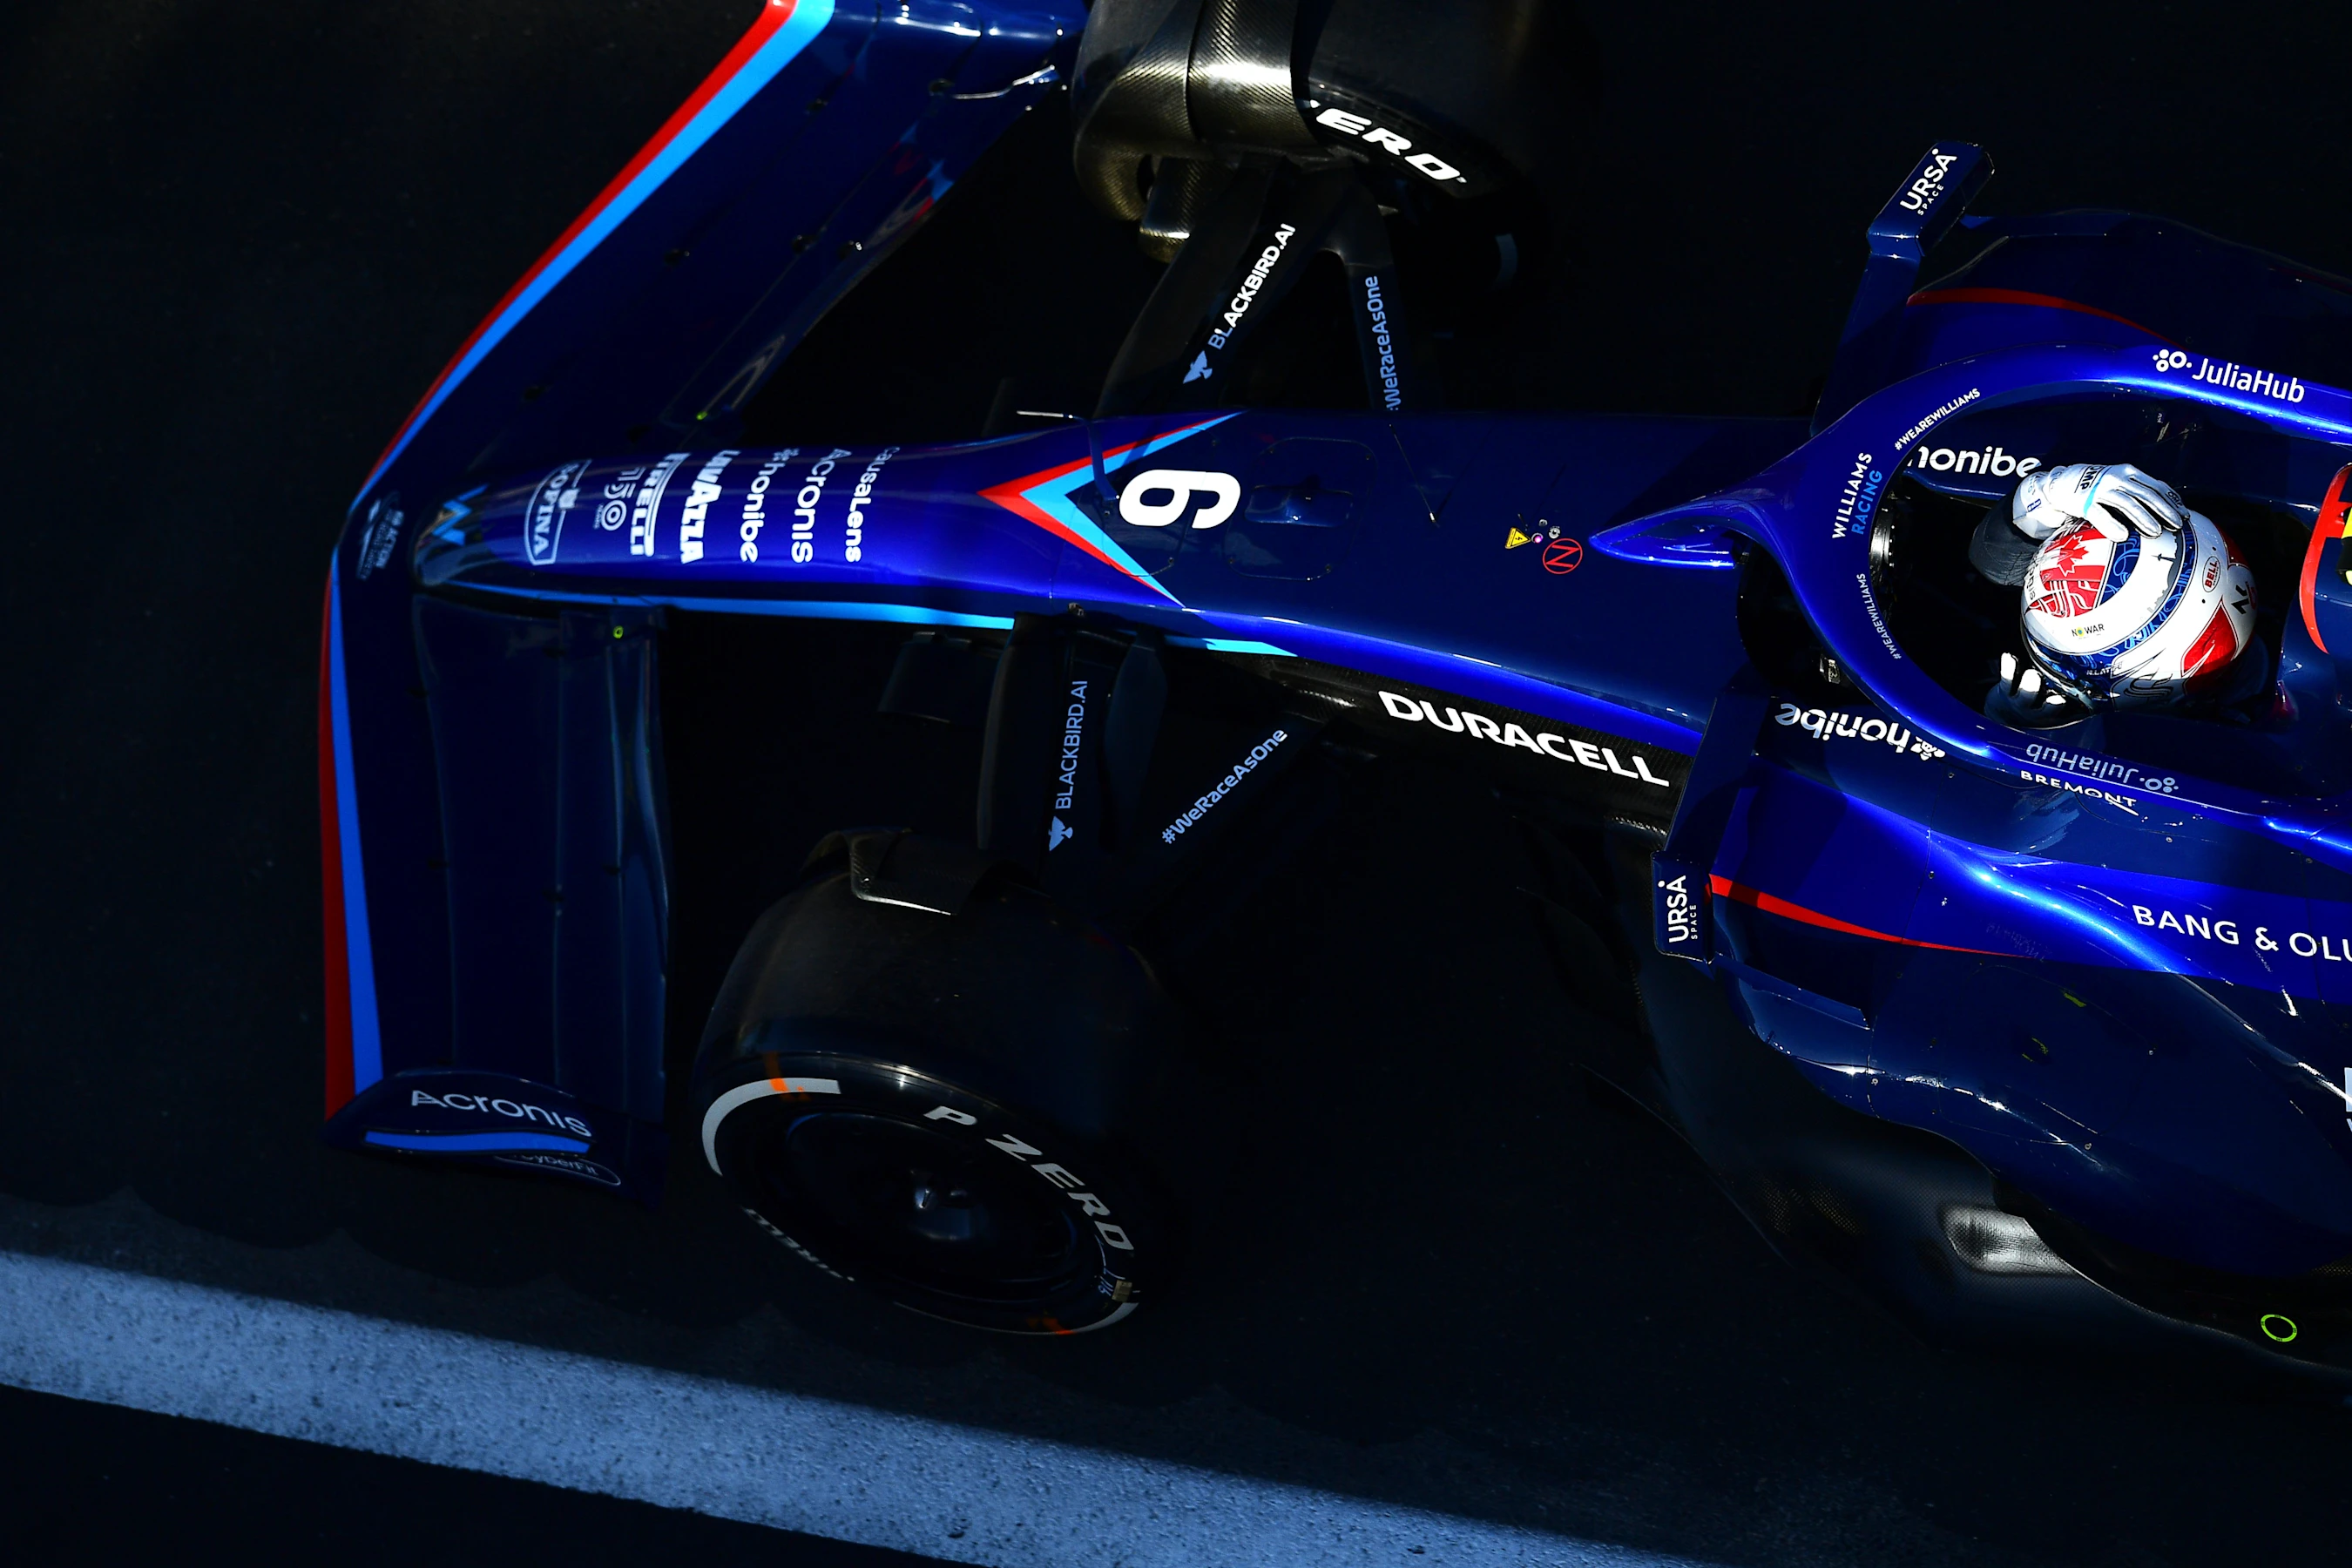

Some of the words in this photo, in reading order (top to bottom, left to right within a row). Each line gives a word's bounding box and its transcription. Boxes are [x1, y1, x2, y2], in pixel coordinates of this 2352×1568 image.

[1310, 98, 1462, 181] ERO
[1916, 183, 1944, 216] SPACE
[1208, 223, 1296, 350] BLACKBIRD.AI
[1364, 275, 1402, 411] WeRaceAsOne
[2191, 358, 2305, 404] JuliaHub
[1894, 388, 1981, 451] #WEAREWILLIAMS
[630, 451, 692, 557] PIRELLI
[679, 449, 742, 564] LAVAZZA
[739, 461, 787, 564] honibe
[844, 445, 901, 563] causaLens
[1119, 469, 1241, 530] 6
[1831, 452, 1873, 539] WILLIAMS
[1851, 470, 1883, 535] RACING
[1855, 572, 1903, 660] #WEAREWILLIAMS
[2204, 560, 2219, 589] BELL
[2085, 623, 2105, 635] WAR
[1055, 680, 1088, 810] BLACKBIRD.AI
[1378, 691, 1670, 787] DURACELL
[1774, 702, 1911, 754] honibe
[2025, 743, 2139, 784] JuliaHub
[1161, 729, 1288, 844] #WeRaceAsOne
[2020, 769, 2139, 814] BREMONT
[1689, 904, 1699, 940] SPACE
[2132, 904, 2240, 945] BANG
[2254, 926, 2279, 951] &
[923, 1105, 978, 1125] P
[984, 1133, 1134, 1251] ZERO
